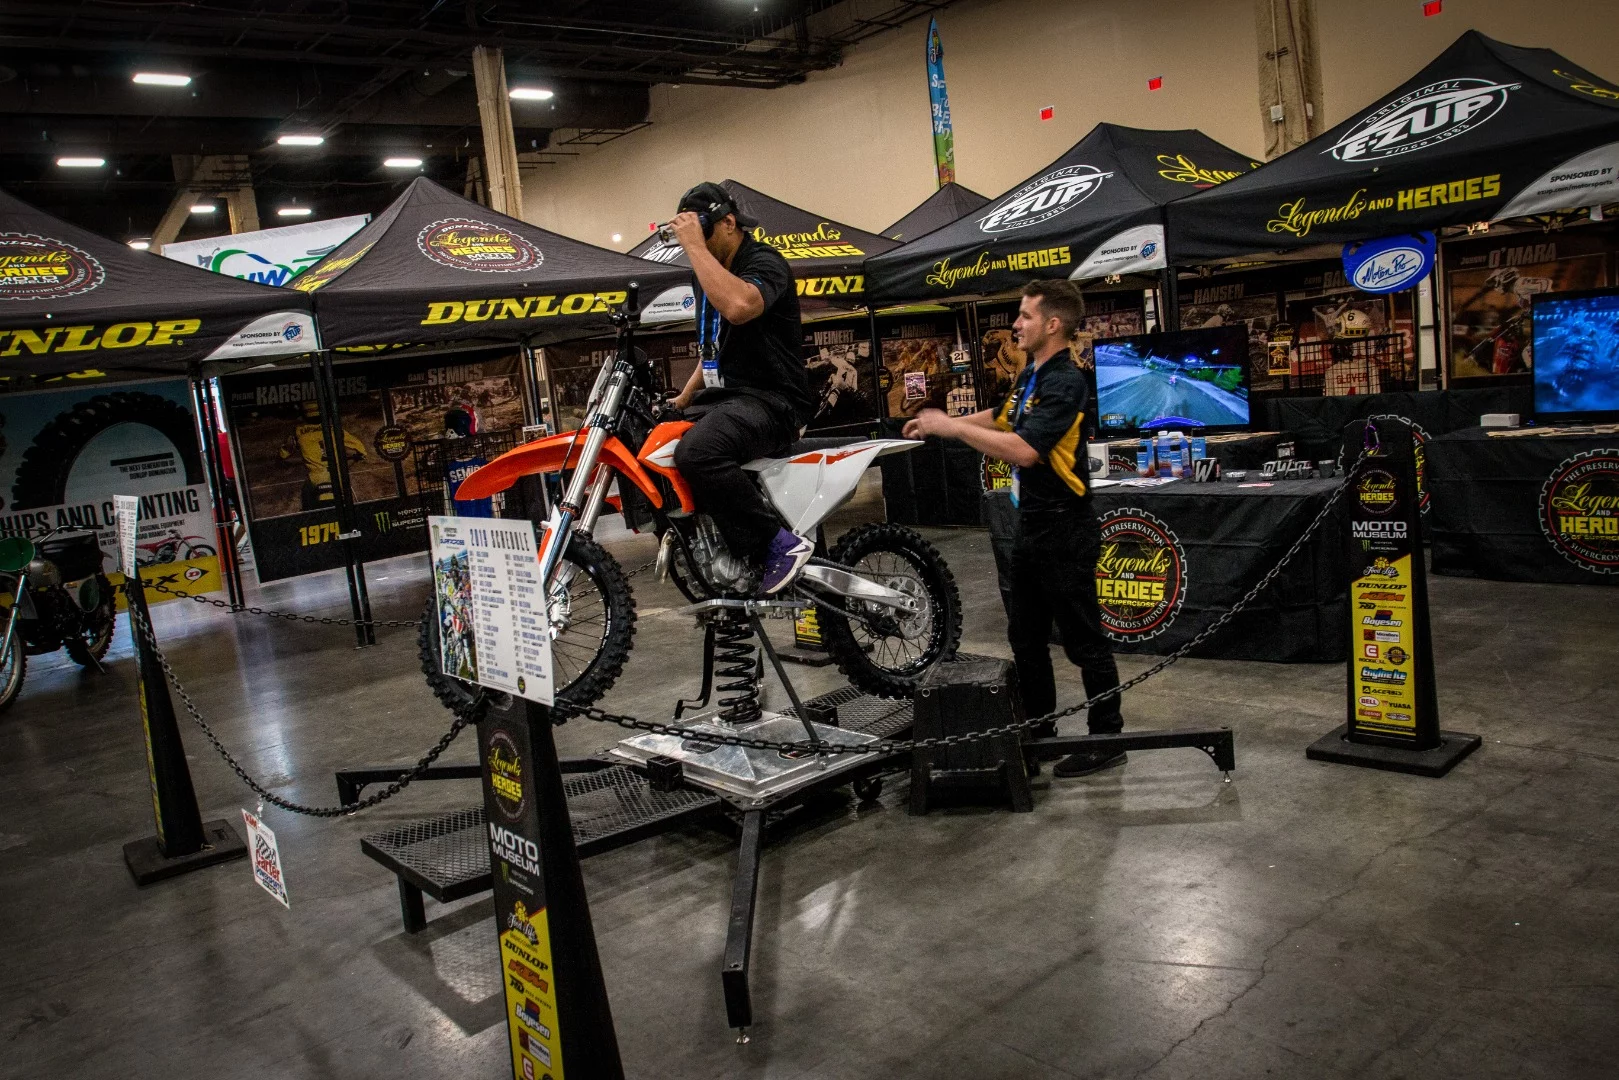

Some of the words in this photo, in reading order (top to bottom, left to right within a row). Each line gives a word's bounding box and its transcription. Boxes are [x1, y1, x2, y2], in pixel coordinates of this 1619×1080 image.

[1366, 81, 1461, 125] ORIGINAL
[1550, 170, 1599, 183] SPONSORED
[1601, 167, 1613, 175] BY
[1537, 180, 1613, 195] ezup.com/motorsports
[1266, 188, 1368, 238] Legends
[1368, 197, 1394, 211] AND
[1397, 174, 1501, 211] HEROES
[430, 232, 511, 247] Legends
[449, 246, 517, 256] HEROES
[778, 244, 866, 260] EROES
[1101, 246, 1129, 255] SPONSORED
[1488, 243, 1557, 269] O'MARA
[926, 252, 991, 289] Legends
[991, 258, 1007, 270] AND
[1007, 246, 1071, 271] HEROES
[1362, 260, 1392, 284] Motion
[1393, 254, 1415, 273] Pro
[794, 275, 865, 297] UNL
[1194, 283, 1244, 304] HANSEN
[421, 290, 627, 327] DUNLOP
[1347, 313, 1355, 321] 6
[989, 314, 1009, 327] BELL
[0, 319, 201, 357] NLOP
[814, 329, 854, 345] WEINERT
[427, 364, 483, 385] SEMICS
[256, 376, 367, 406] KARSMERS
[1564, 469, 1582, 483] THE
[1360, 493, 1394, 501] HEROES
[0, 511, 50, 539] HIPS
[57, 504, 98, 534] AND
[102, 489, 200, 526] CNTING
[299, 521, 340, 547] 1974
[1111, 522, 1165, 547] PRESERVATION
[1352, 521, 1407, 531] MOTO
[1353, 531, 1407, 539] MUSEUM
[1559, 517, 1619, 534] HERO
[491, 529, 530, 551] SCHEDULE
[1097, 543, 1172, 579] Legends
[1570, 543, 1619, 561] SUPERCROS
[1356, 582, 1407, 590] DUNLOP
[1100, 611, 1141, 628] PERCROSS
[1142, 598, 1169, 626] HISTORY
[1362, 616, 1402, 627] Boyesen
[1362, 667, 1393, 680] Engine
[1393, 669, 1407, 680] Ice
[1389, 702, 1412, 710] YUASA
[491, 772, 523, 798] HEROES
[490, 822, 538, 862] MOTO
[493, 841, 540, 877] MUSEUM
[505, 939, 548, 970] DUNLOP
[516, 1003, 550, 1039] Boyesen
